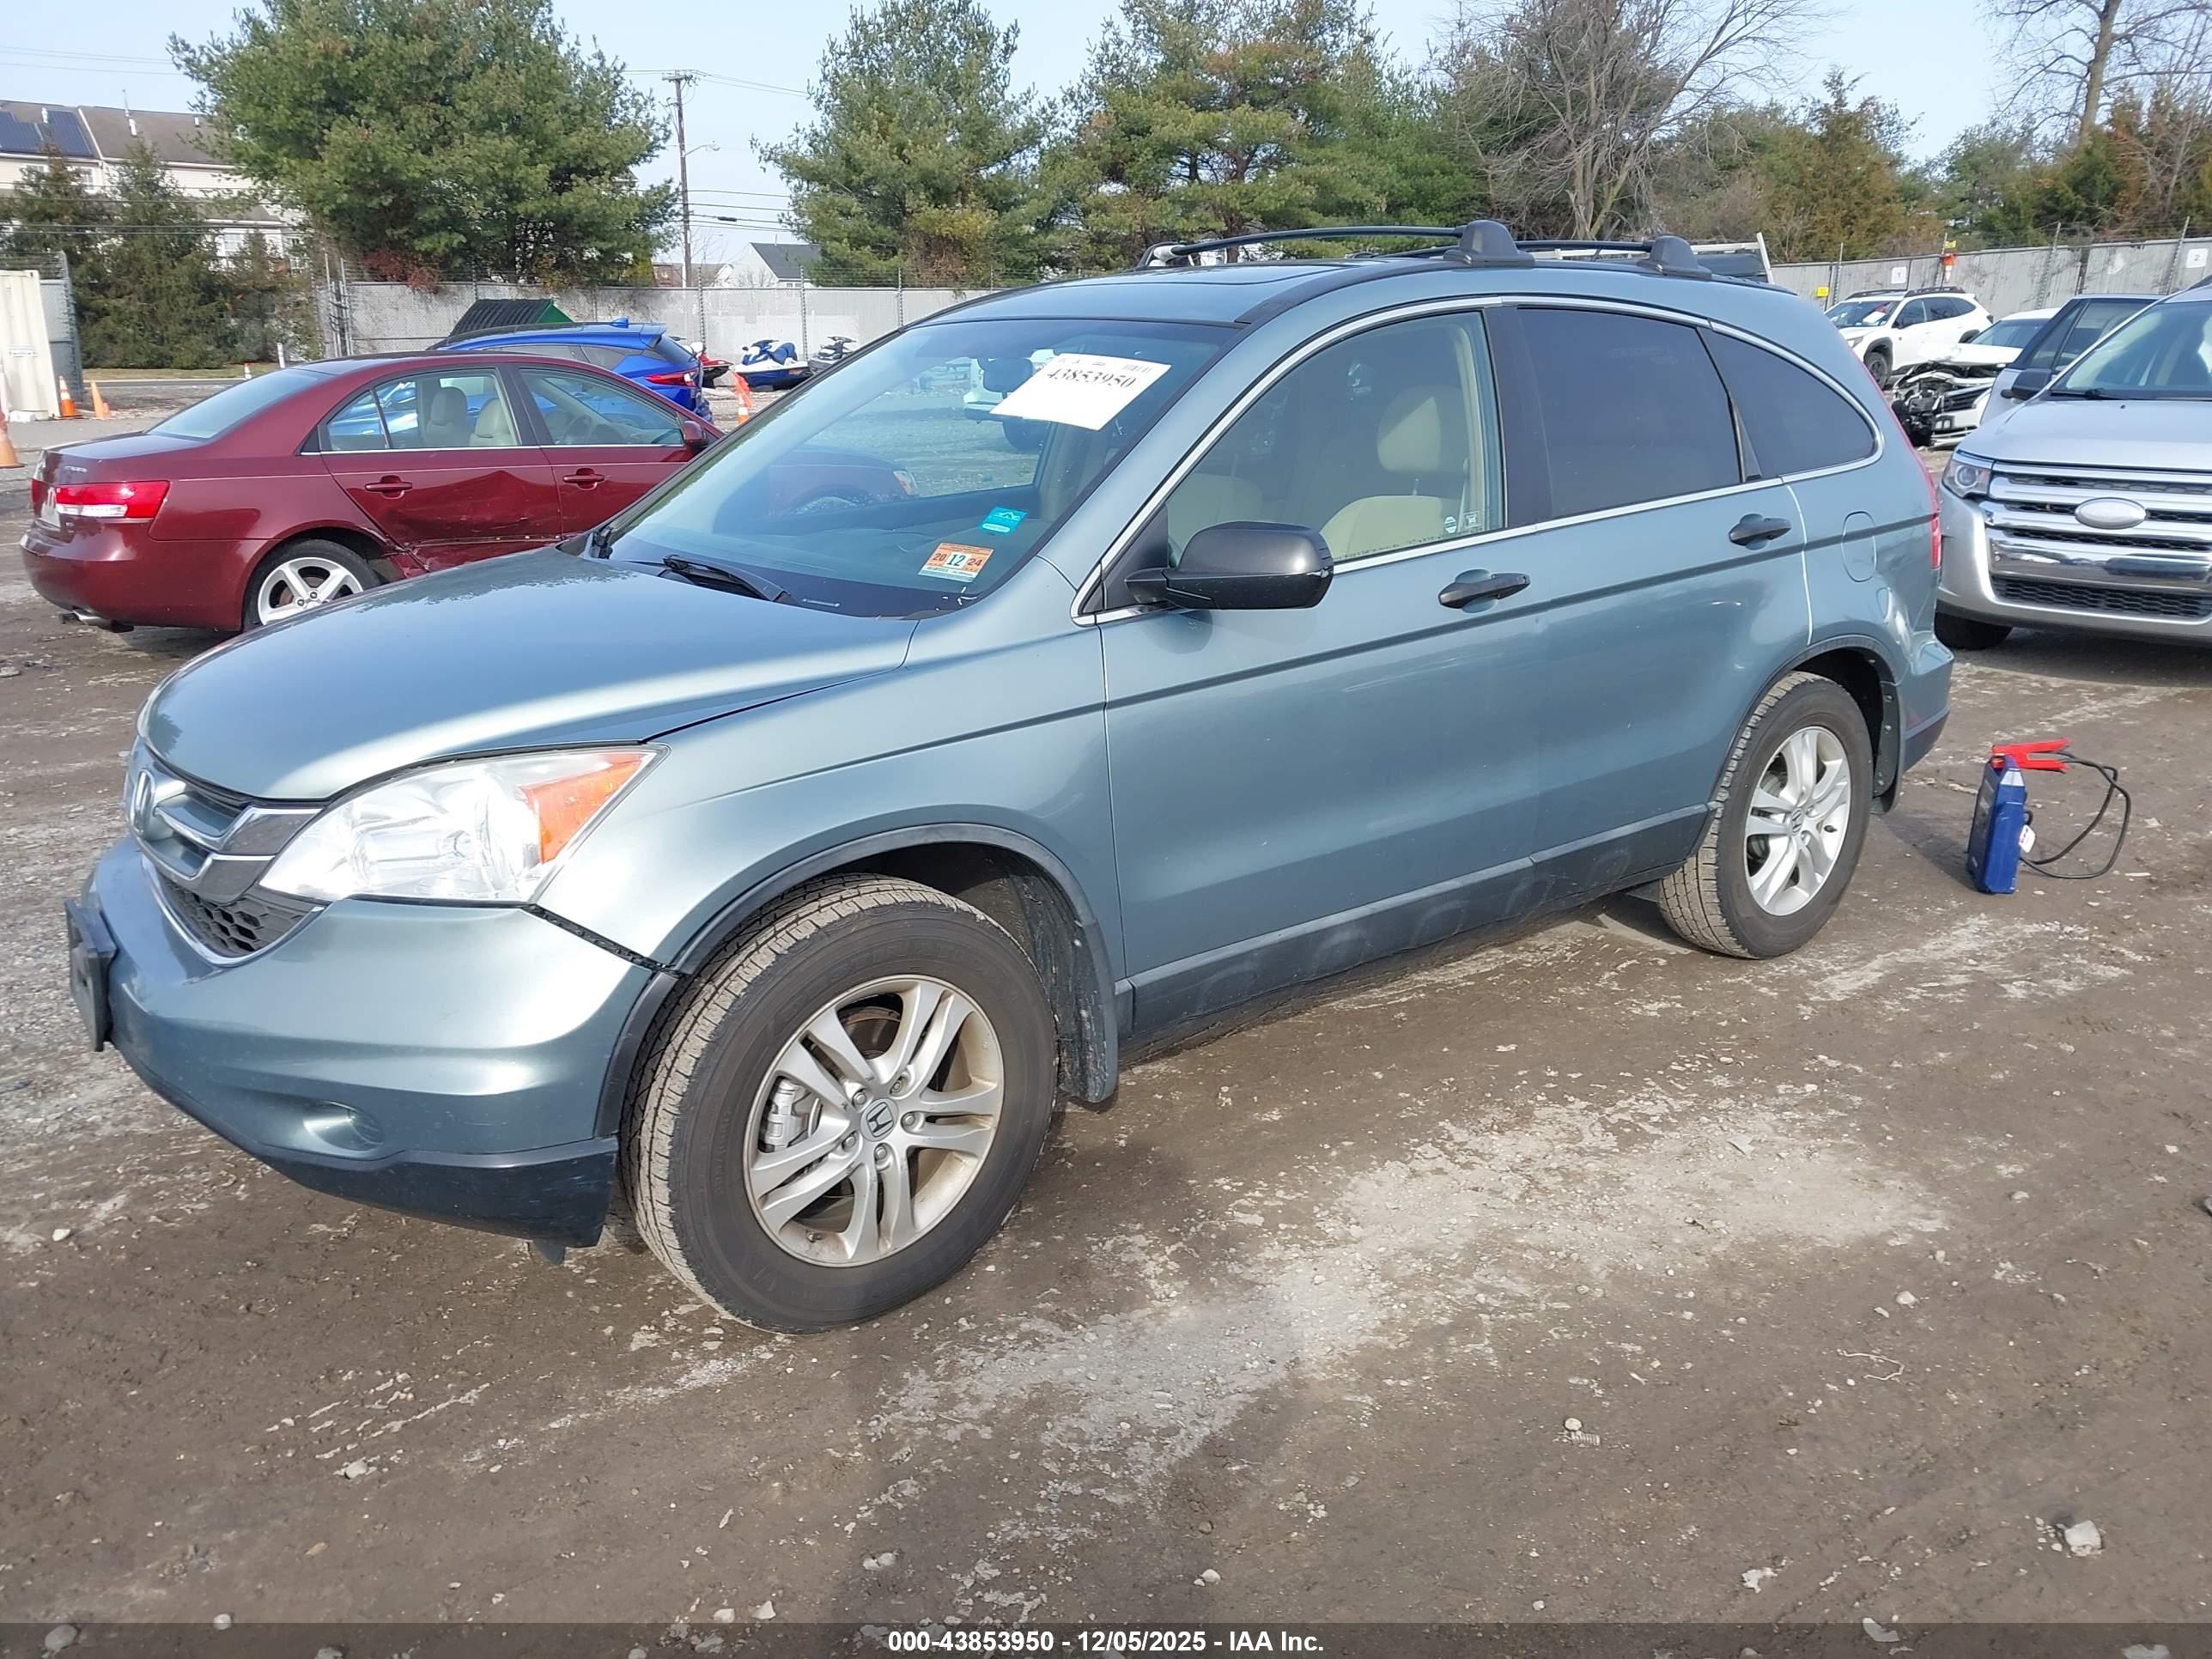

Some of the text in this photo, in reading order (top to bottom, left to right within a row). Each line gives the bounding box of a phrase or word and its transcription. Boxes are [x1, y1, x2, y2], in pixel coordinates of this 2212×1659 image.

[1047, 368, 1137, 388] 43853950
[933, 553, 947, 562] 20
[946, 554, 966, 567] 12
[967, 558, 983, 567] 24
